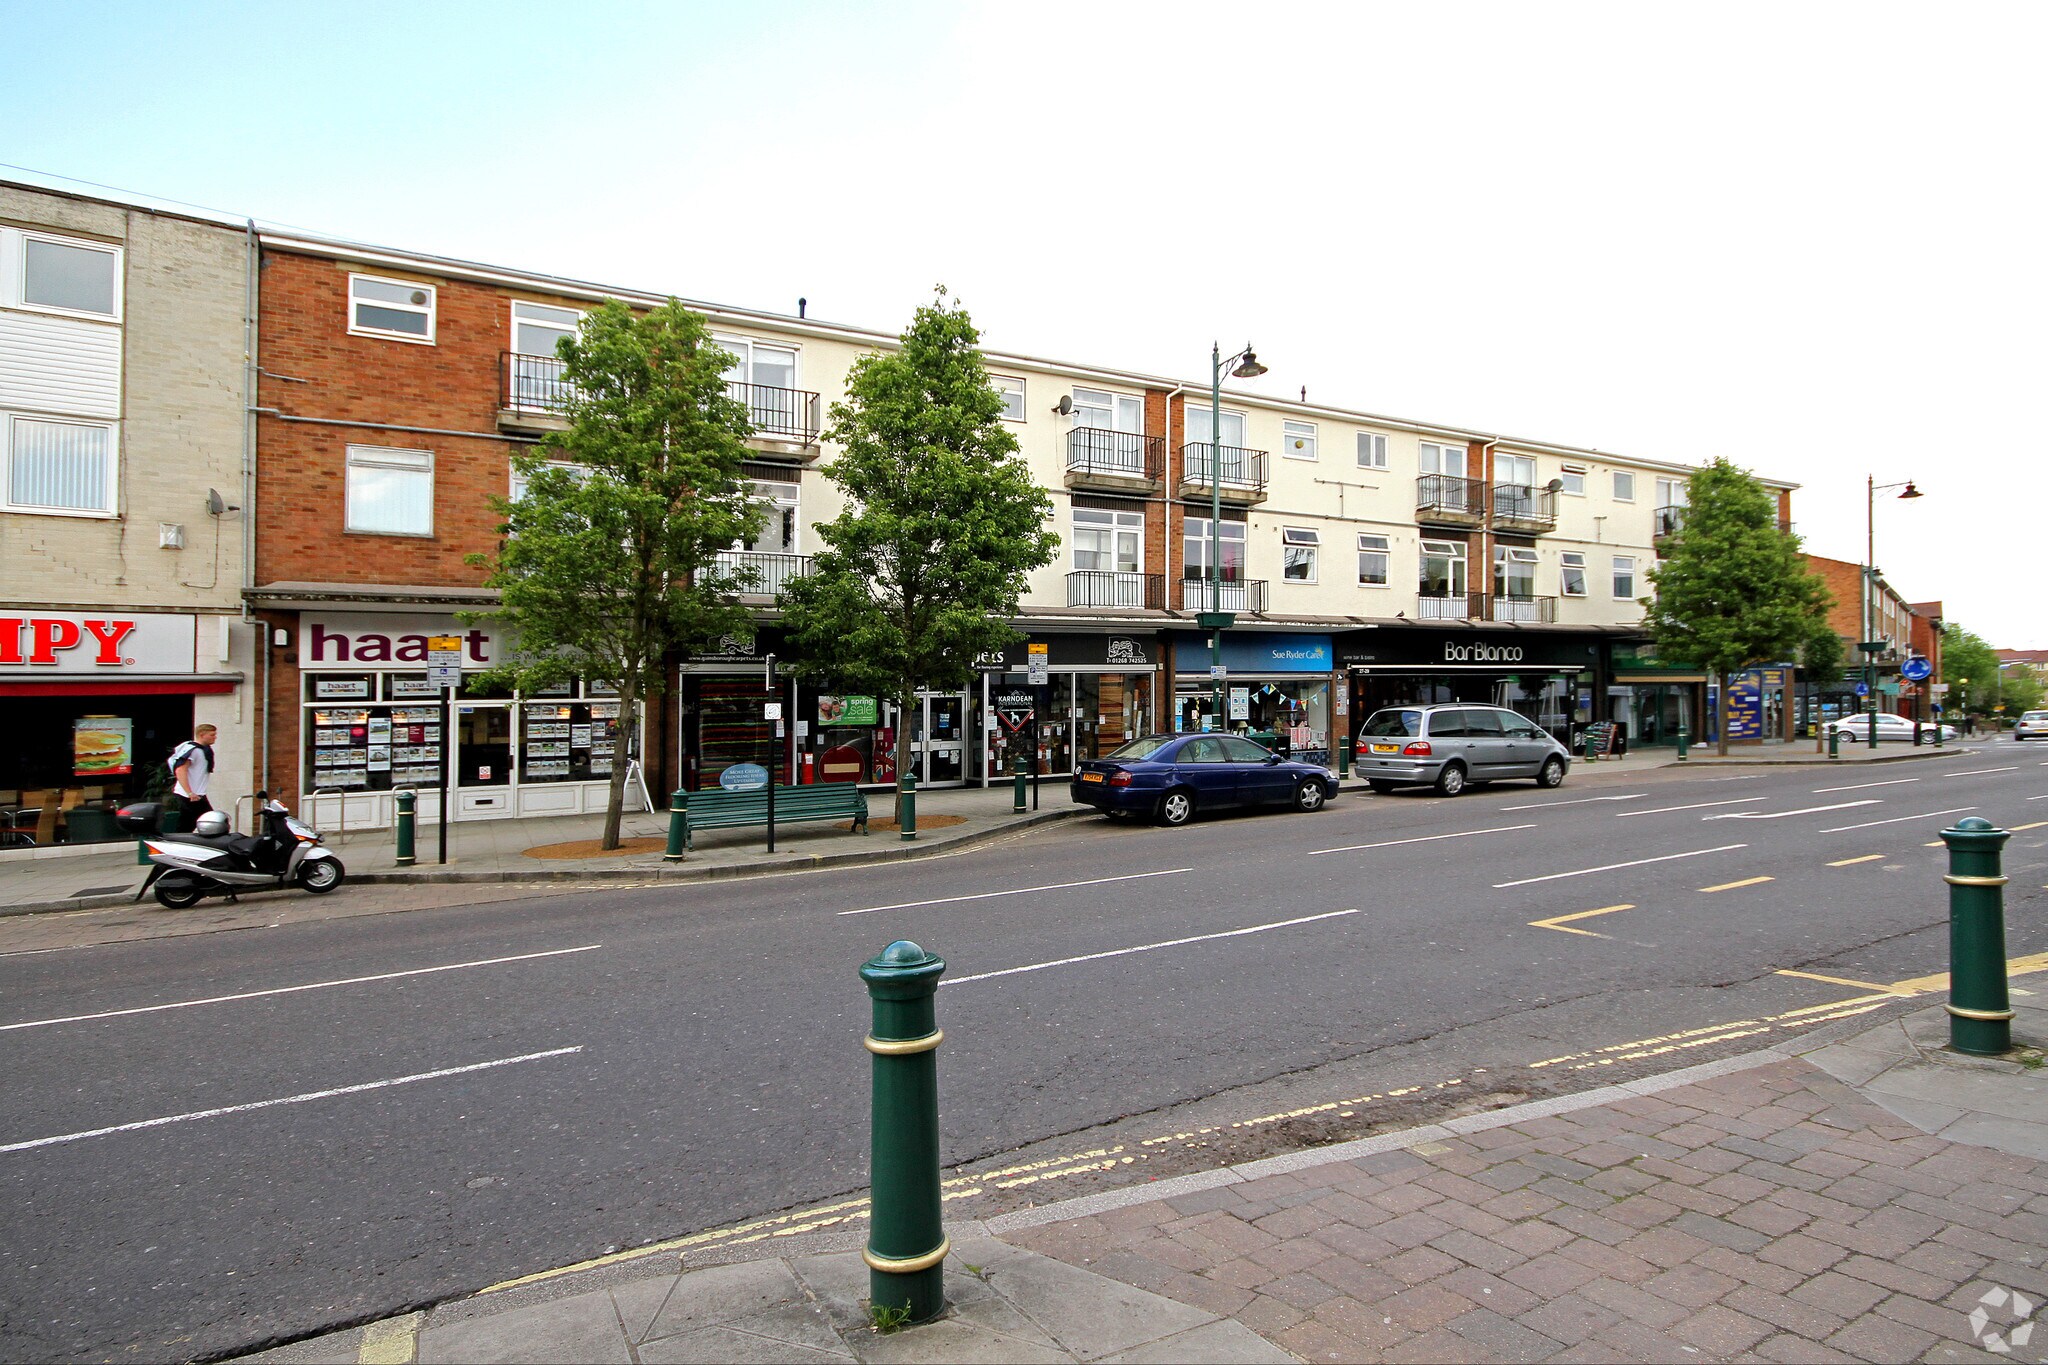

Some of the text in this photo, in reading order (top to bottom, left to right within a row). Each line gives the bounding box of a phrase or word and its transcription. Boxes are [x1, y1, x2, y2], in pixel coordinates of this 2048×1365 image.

[311, 624, 489, 662] haat
[1272, 650, 1321, 660] Sue Ryder Care
[850, 705, 873, 715] sale
